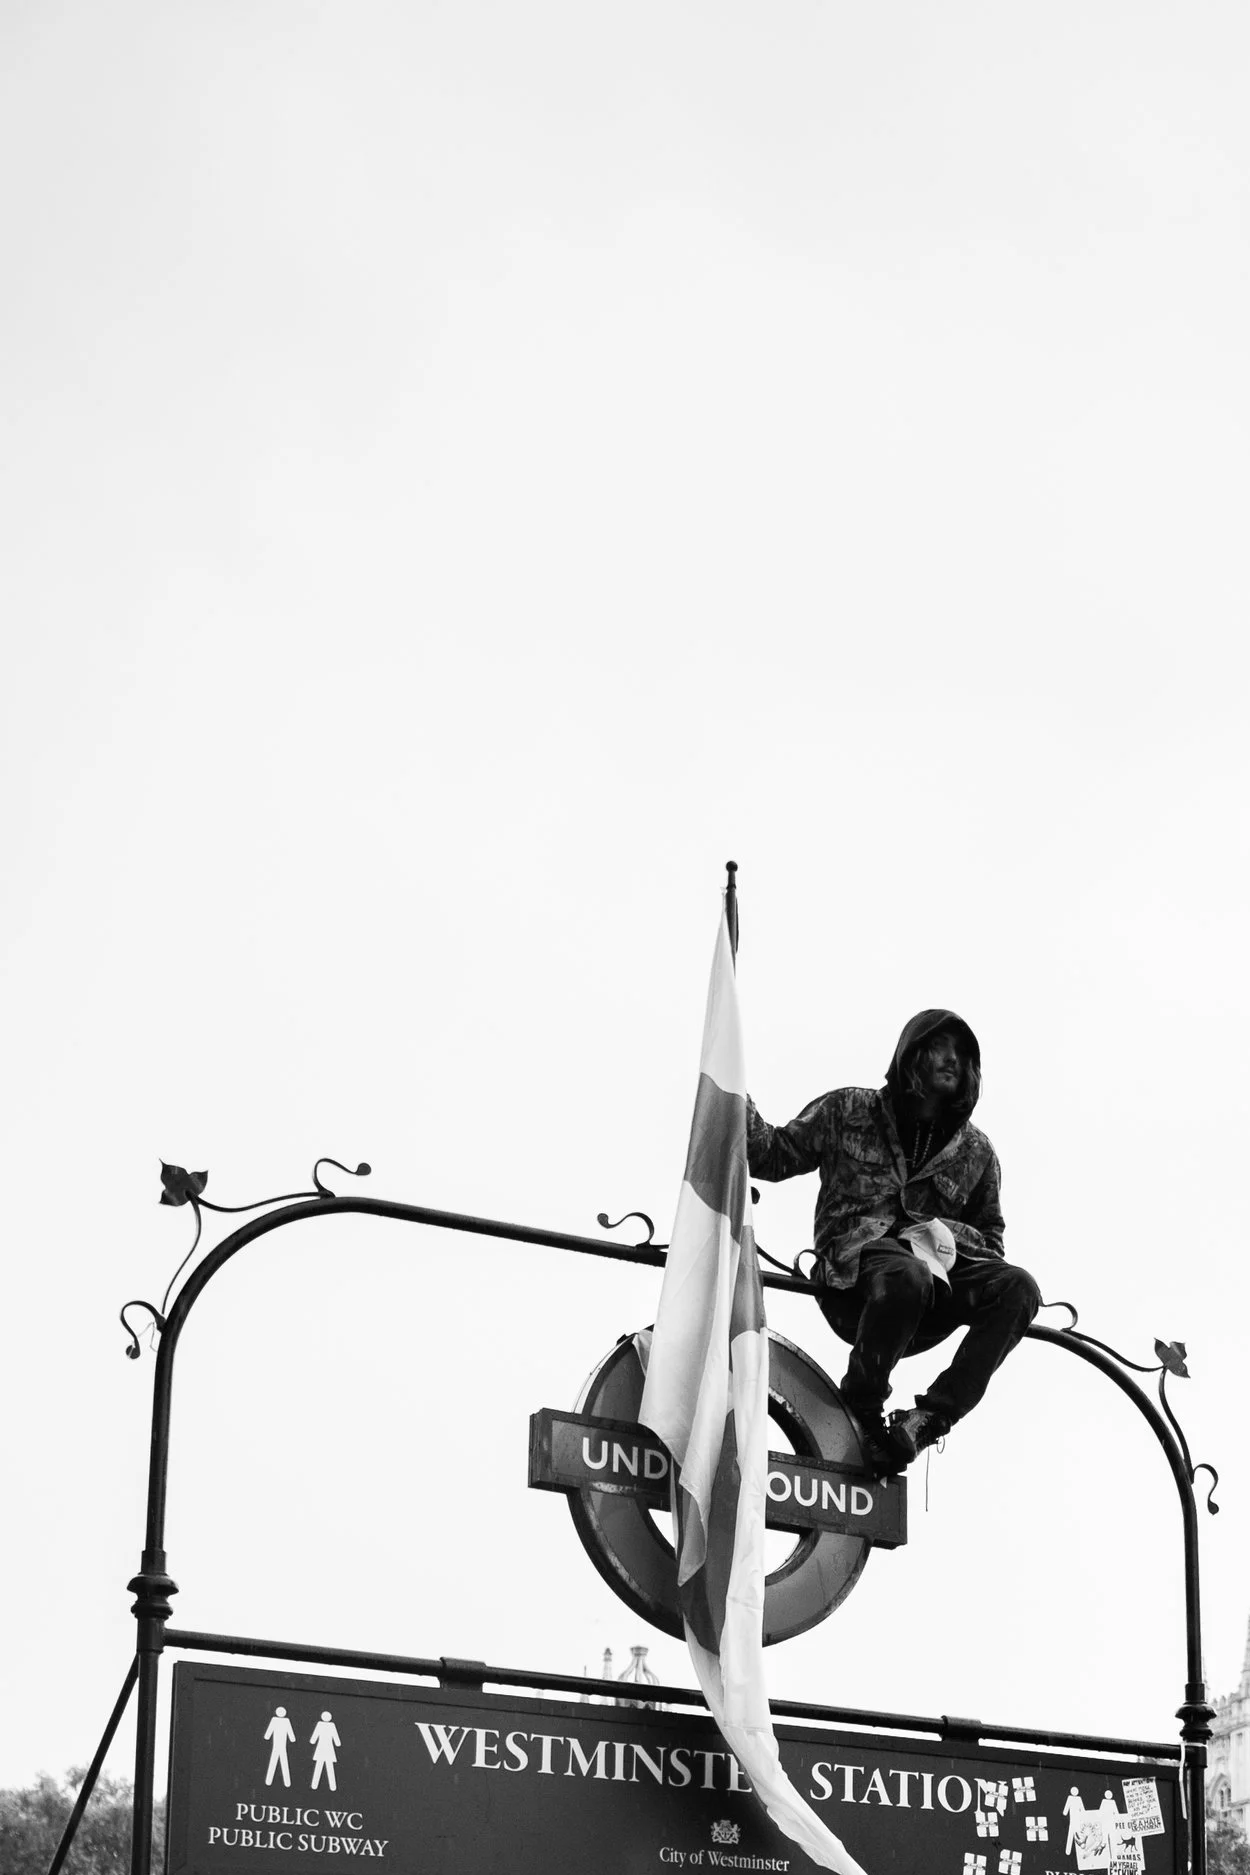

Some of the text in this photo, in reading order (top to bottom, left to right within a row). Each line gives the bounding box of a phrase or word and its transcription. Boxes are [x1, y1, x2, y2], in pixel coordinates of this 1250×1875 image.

[581, 1437, 874, 1516] UNDOUND
[415, 1722, 1008, 1816] WESTMINSTE STATION
[235, 1803, 363, 1830] PUBLIC WC
[208, 1826, 389, 1858] PUBLIC SUBWAY
[659, 1846, 790, 1873] City of Westminster
